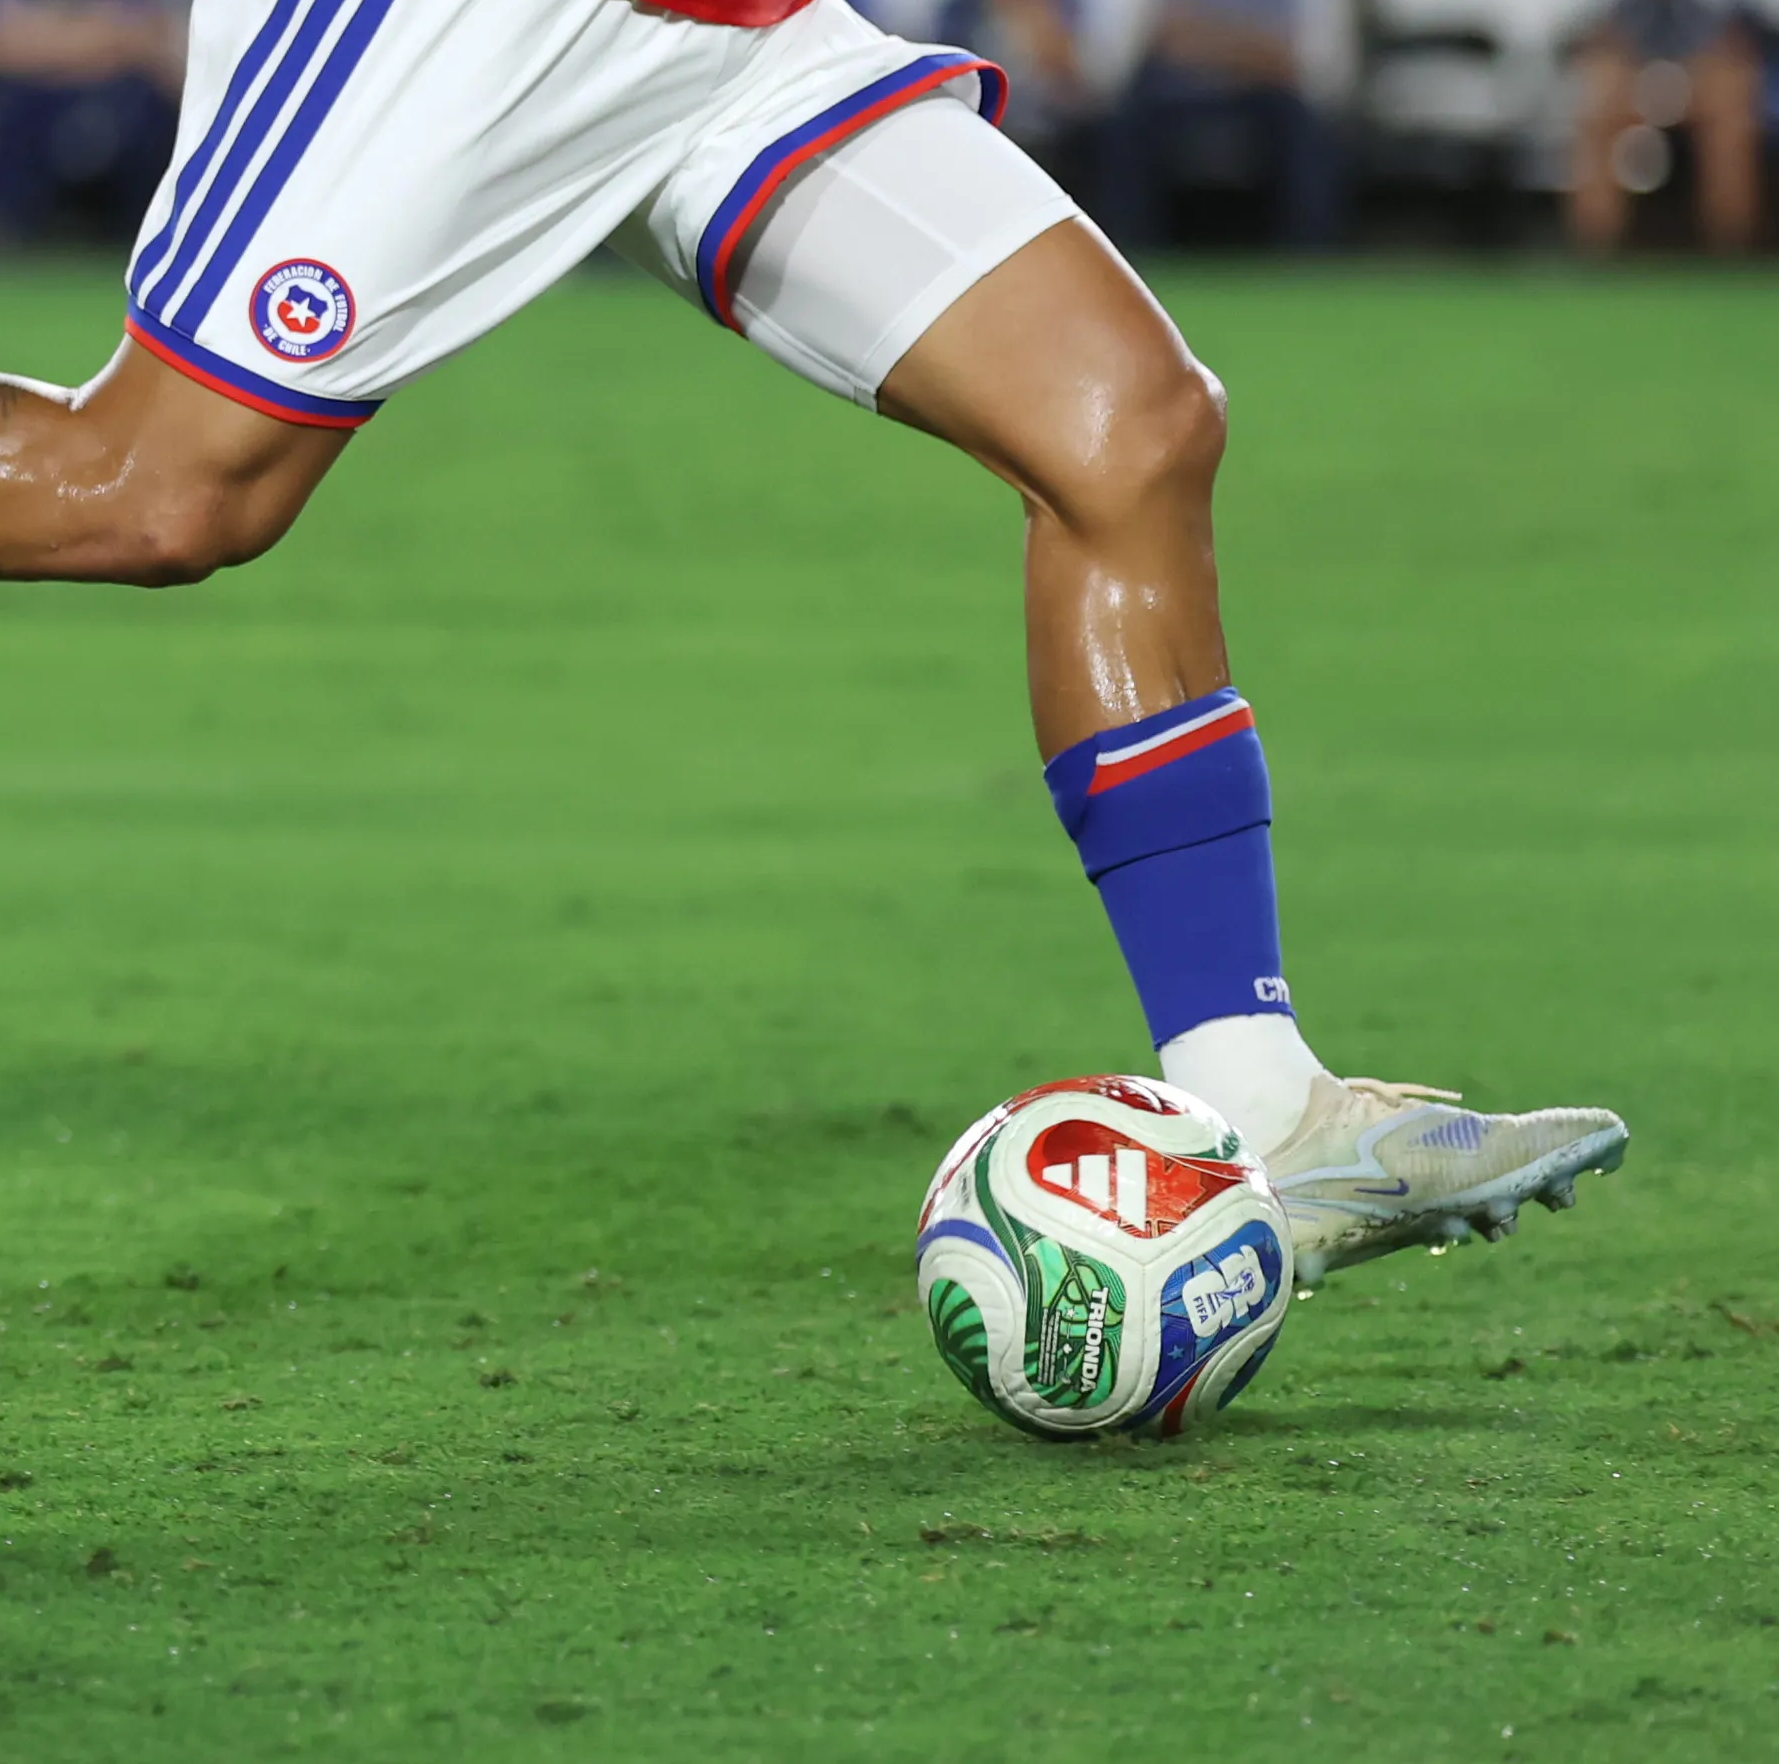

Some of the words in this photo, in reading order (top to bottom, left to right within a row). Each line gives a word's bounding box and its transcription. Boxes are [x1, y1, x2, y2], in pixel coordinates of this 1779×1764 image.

[324, 277, 341, 293] DE
[1192, 1296, 1209, 1326] FIFA
[1080, 1286, 1110, 1394] TRIONDA
